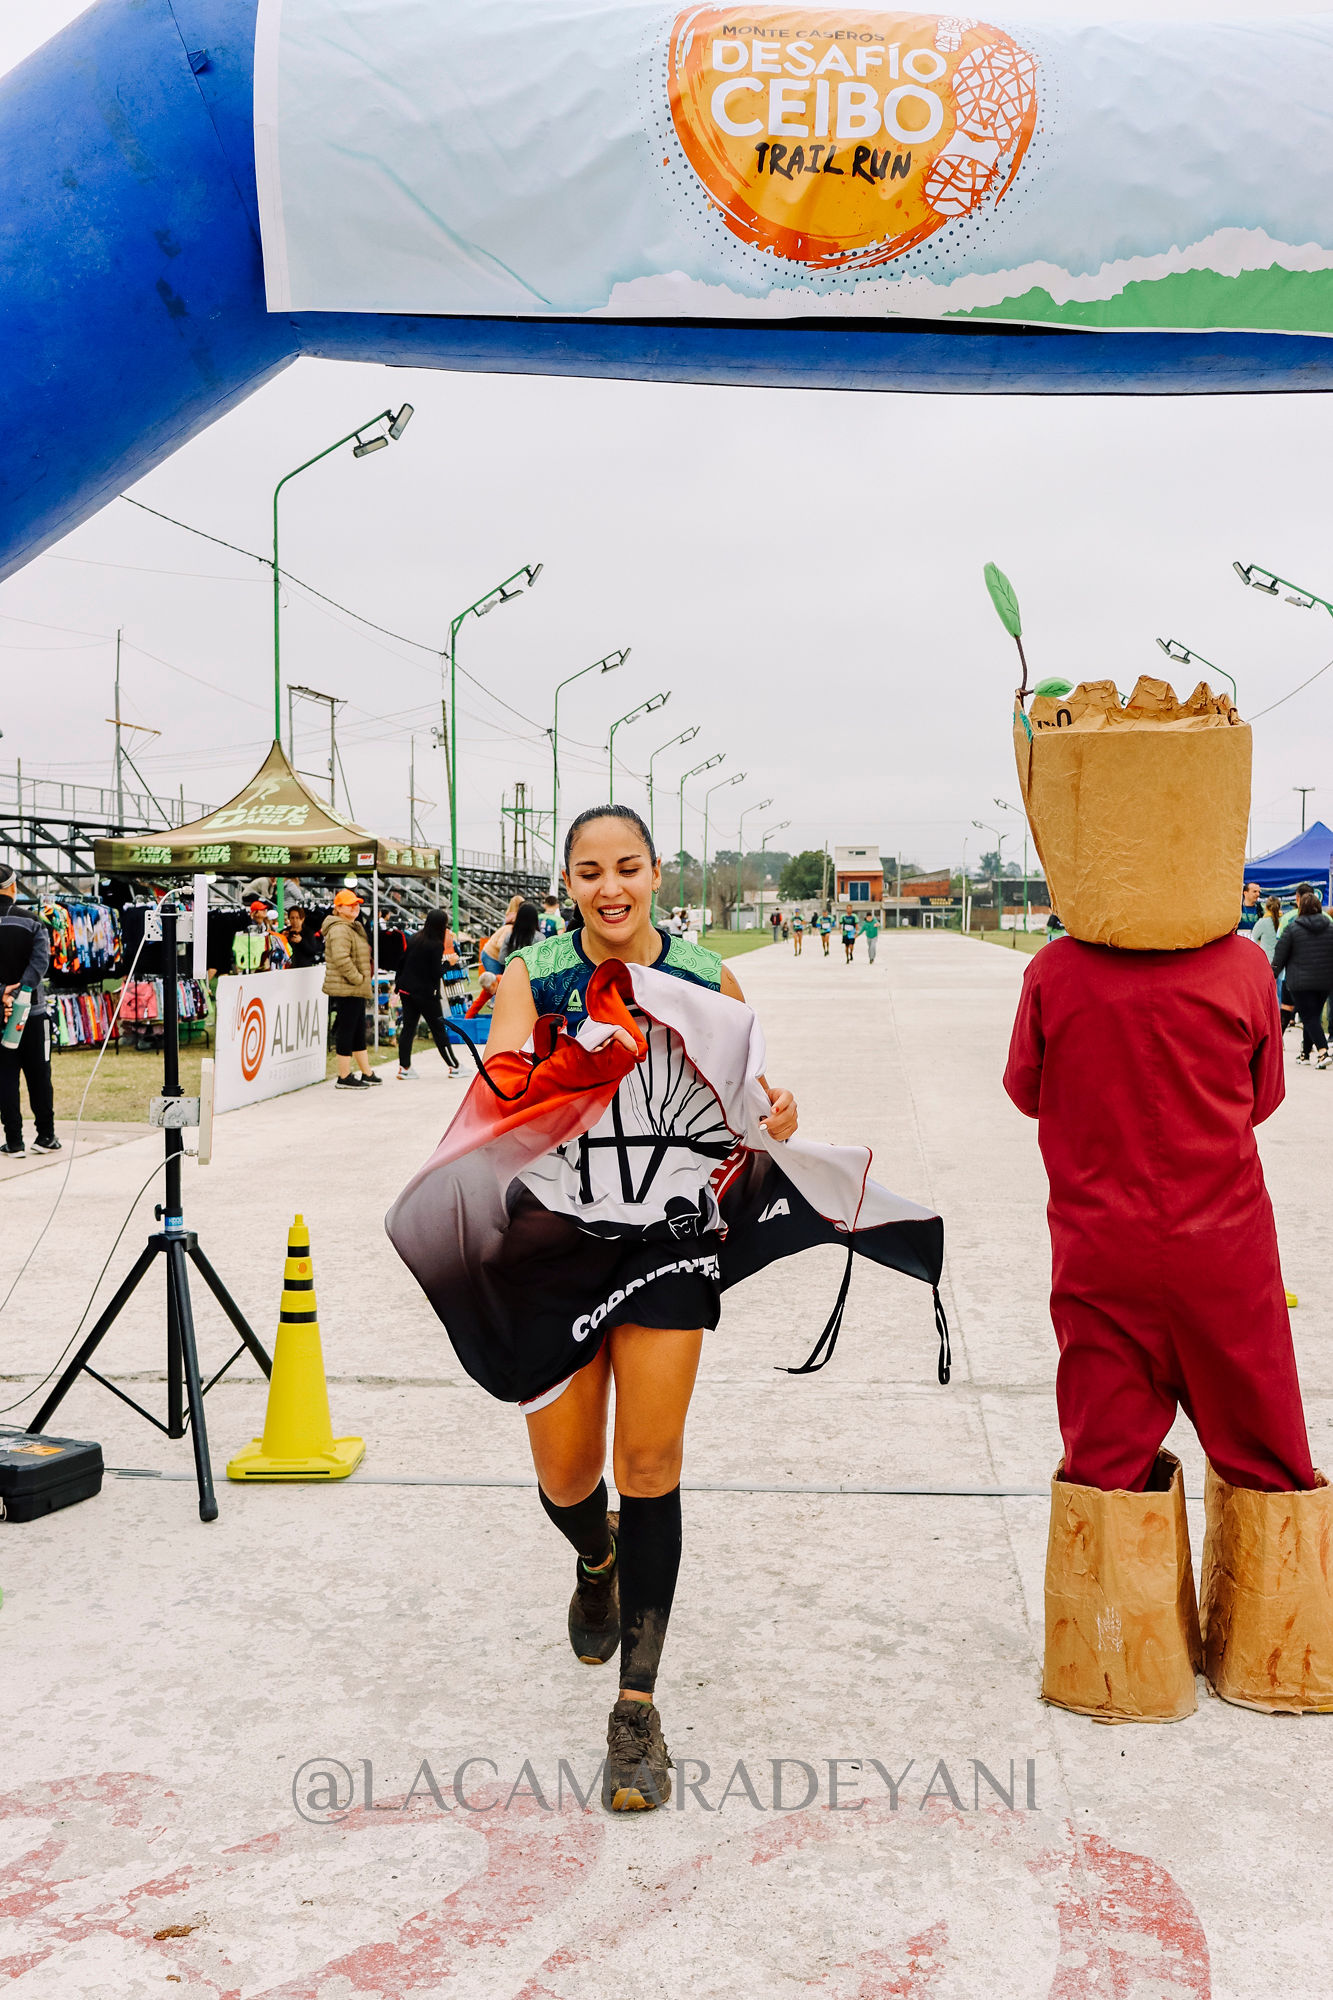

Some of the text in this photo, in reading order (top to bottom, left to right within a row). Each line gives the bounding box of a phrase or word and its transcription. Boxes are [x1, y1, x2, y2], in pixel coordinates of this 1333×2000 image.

[722, 25, 885, 42] MONTE CASEROS
[712, 39, 947, 83] DESAFÍO
[710, 76, 944, 144] CEIBO
[754, 141, 913, 185] TRAIL RUN
[271, 999, 321, 1057] ALMA
